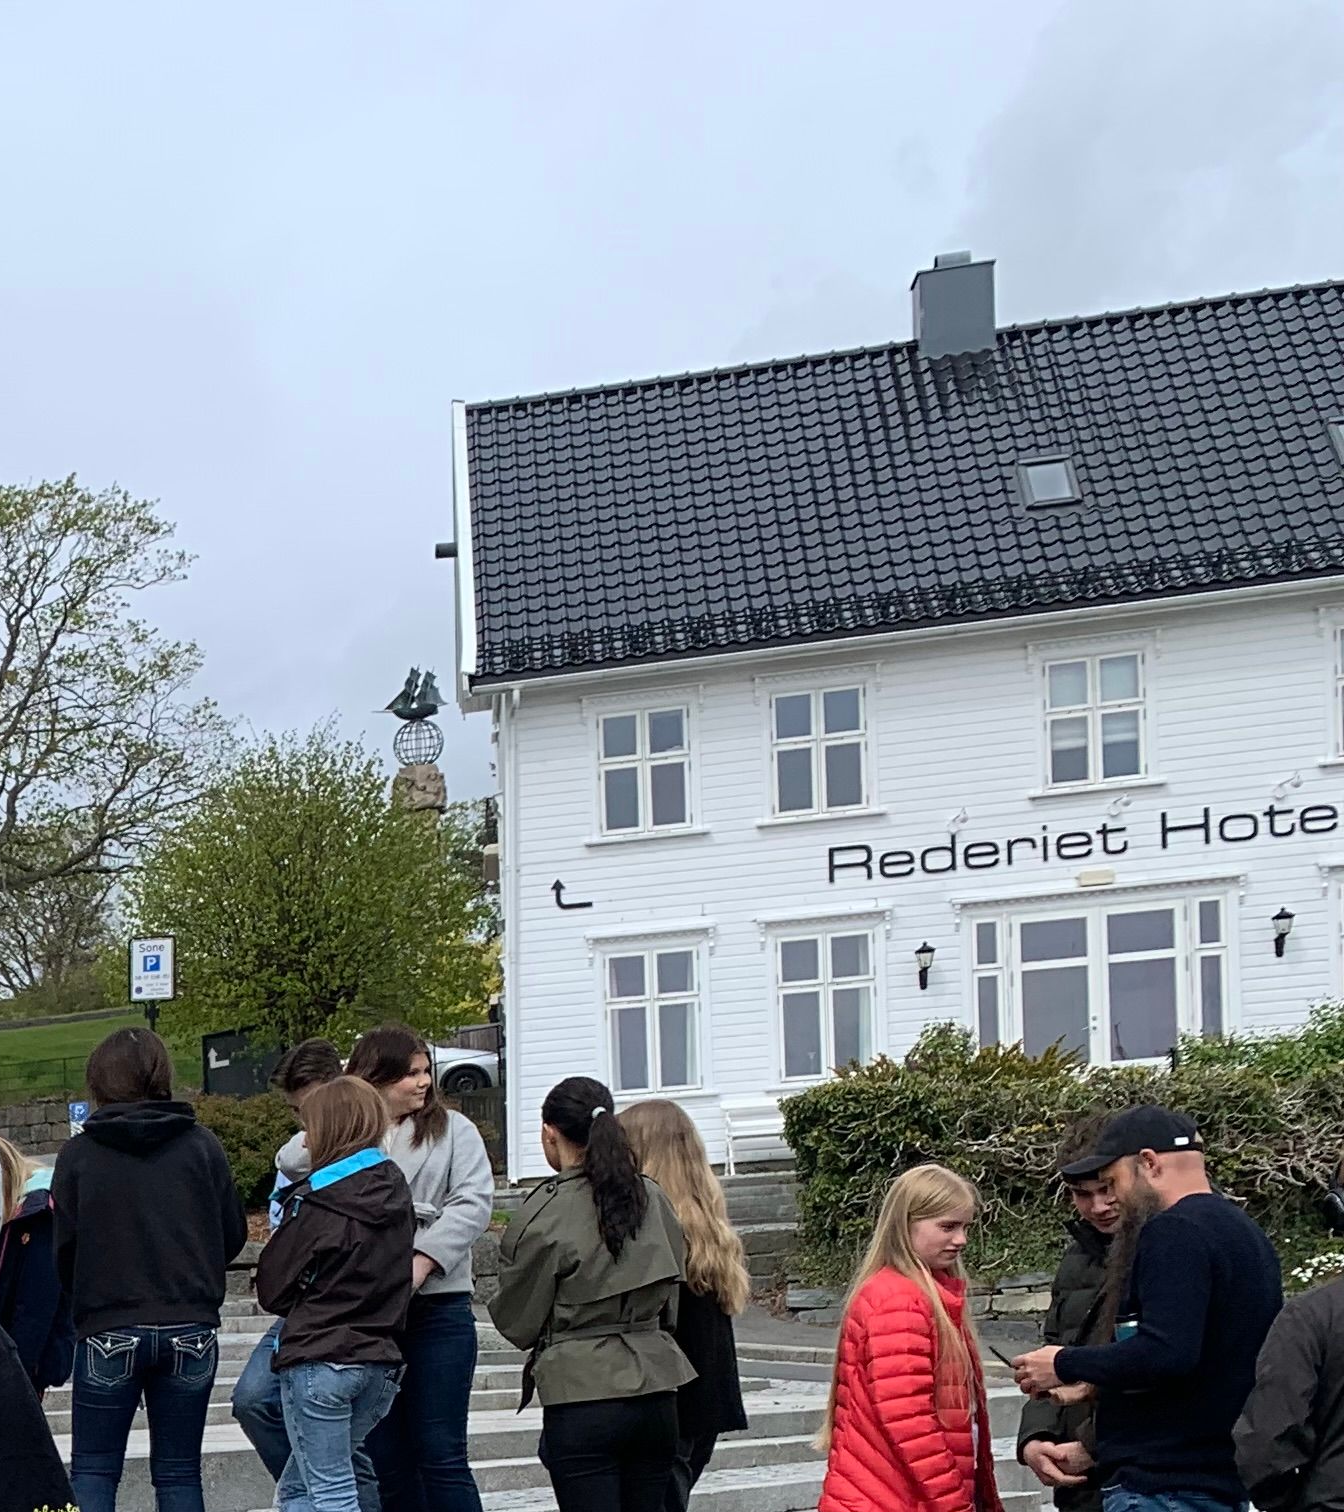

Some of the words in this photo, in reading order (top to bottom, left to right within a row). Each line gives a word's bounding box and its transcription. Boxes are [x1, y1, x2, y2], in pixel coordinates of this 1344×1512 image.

[827, 821, 1129, 884] Rederiet
[1160, 803, 1340, 850] Hote
[138, 943, 165, 953] Sone
[146, 956, 157, 971] P
